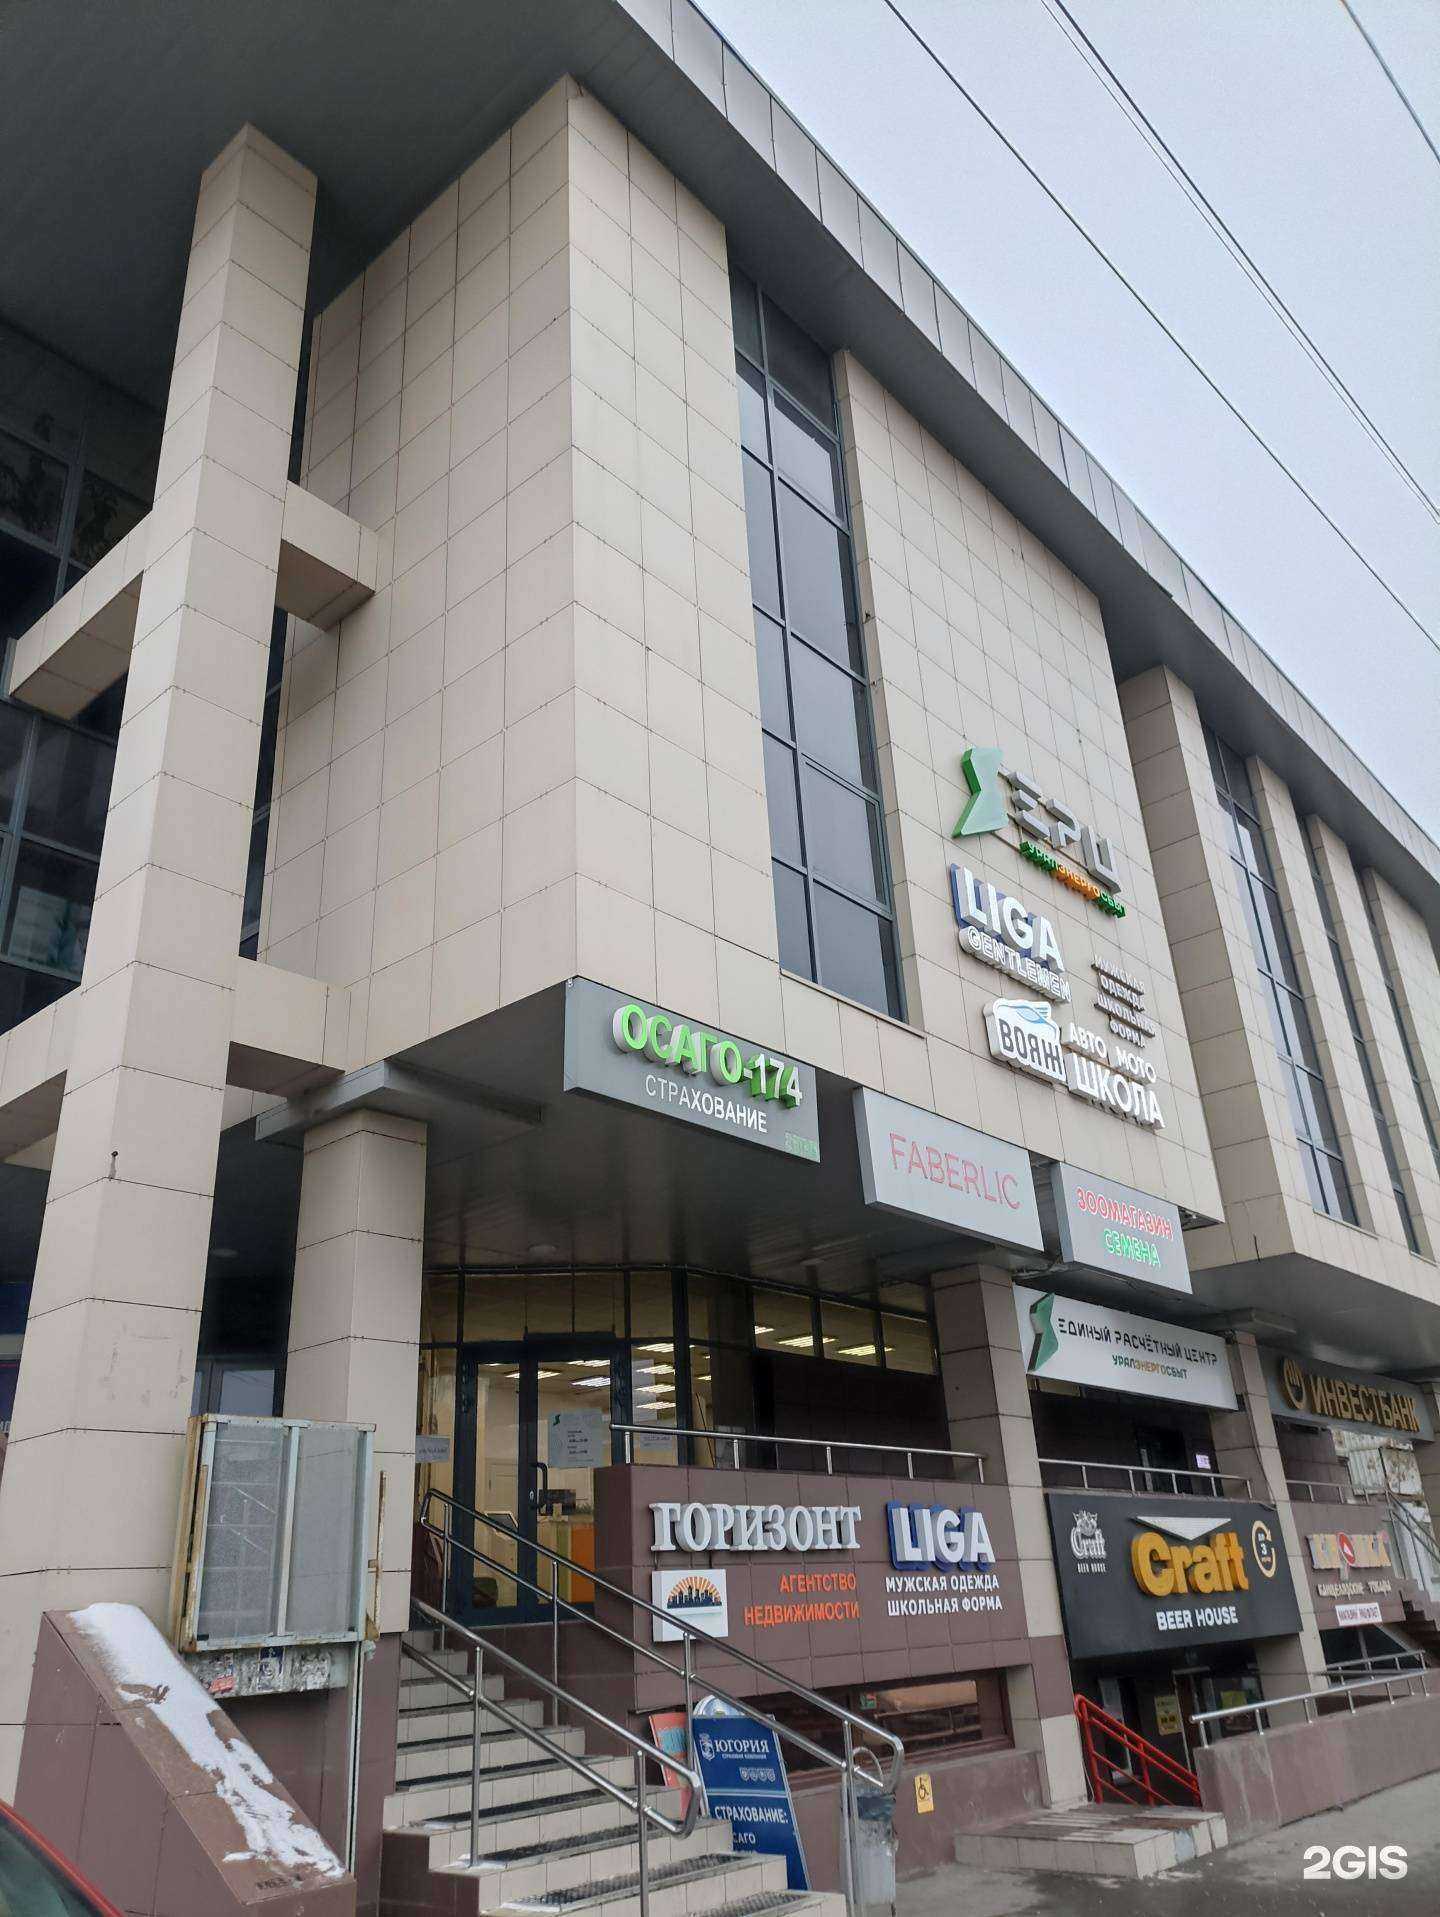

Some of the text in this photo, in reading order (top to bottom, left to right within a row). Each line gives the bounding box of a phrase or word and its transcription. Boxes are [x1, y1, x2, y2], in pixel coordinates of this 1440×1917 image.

[1009, 770, 1122, 893] ЕРЦ
[952, 864, 1065, 974] LIGA
[967, 926, 1072, 1003] GENTLEMEN
[613, 1004, 803, 1108] ОСАГО-174
[999, 1018, 1063, 1077] ВОЯЖ
[1062, 1022, 1157, 1084] АВТО МОТО
[645, 1073, 768, 1134] СТРАХОВАНИЕ
[1066, 1052, 1166, 1130] ШКОЛА
[889, 1133, 1022, 1210] FABERLIC
[1077, 1186, 1174, 1241] ЗООМАГАЗИН
[1103, 1227, 1161, 1268] СЕМЕНА
[1058, 1318, 1218, 1366] ЕДИНЫЙ РАСЧЁТНЫЙ ЦЕНТР
[1112, 1354, 1188, 1379] УРАЛЭНЕРГОСБЫТ
[1310, 1374, 1420, 1432] ИНВЕСТБАНК
[649, 1503, 862, 1552] ГОРИЗОНТ
[887, 1501, 997, 1569] LIGA
[779, 1573, 857, 1593] АГЕНТСТВО
[885, 1573, 1000, 1593] МУЖСКАЯ ОДЕЖДА
[1131, 1532, 1249, 1597] Craft
[743, 1601, 860, 1627] НЕДВИЖИМОСТИ
[887, 1595, 1003, 1616] ШКОЛЬНАЯ ФОРМА
[1156, 1606, 1238, 1631] BEER HOUSE
[715, 1740, 769, 1753] ЮГОРИЯ
[715, 1806, 789, 1824] СТРАХОВАНИЕ:
